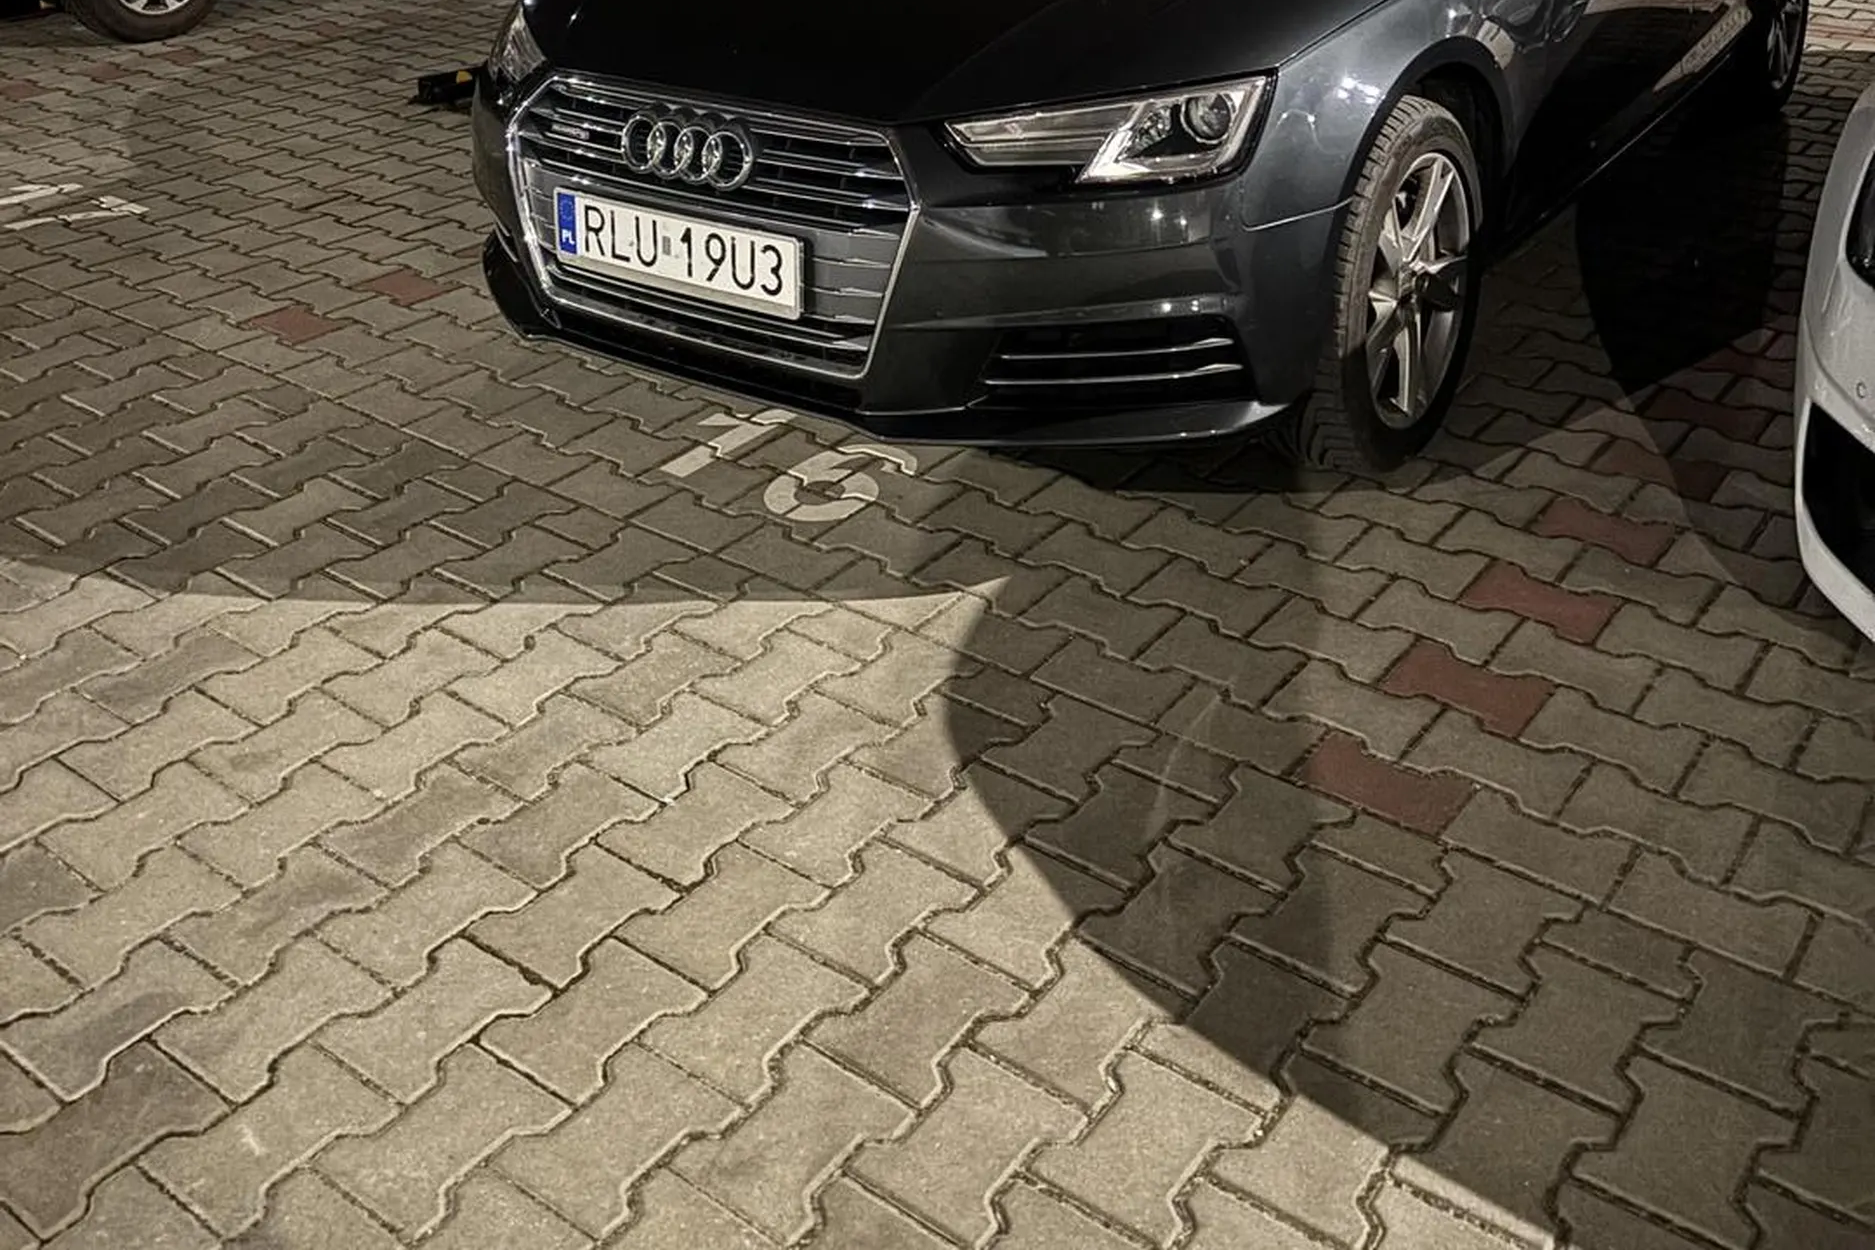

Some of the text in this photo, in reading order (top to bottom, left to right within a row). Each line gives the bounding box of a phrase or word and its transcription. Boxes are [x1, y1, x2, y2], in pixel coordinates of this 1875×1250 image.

[562, 229, 575, 245] PL
[584, 205, 783, 296] RLU 19U3
[660, 408, 918, 522] 16
